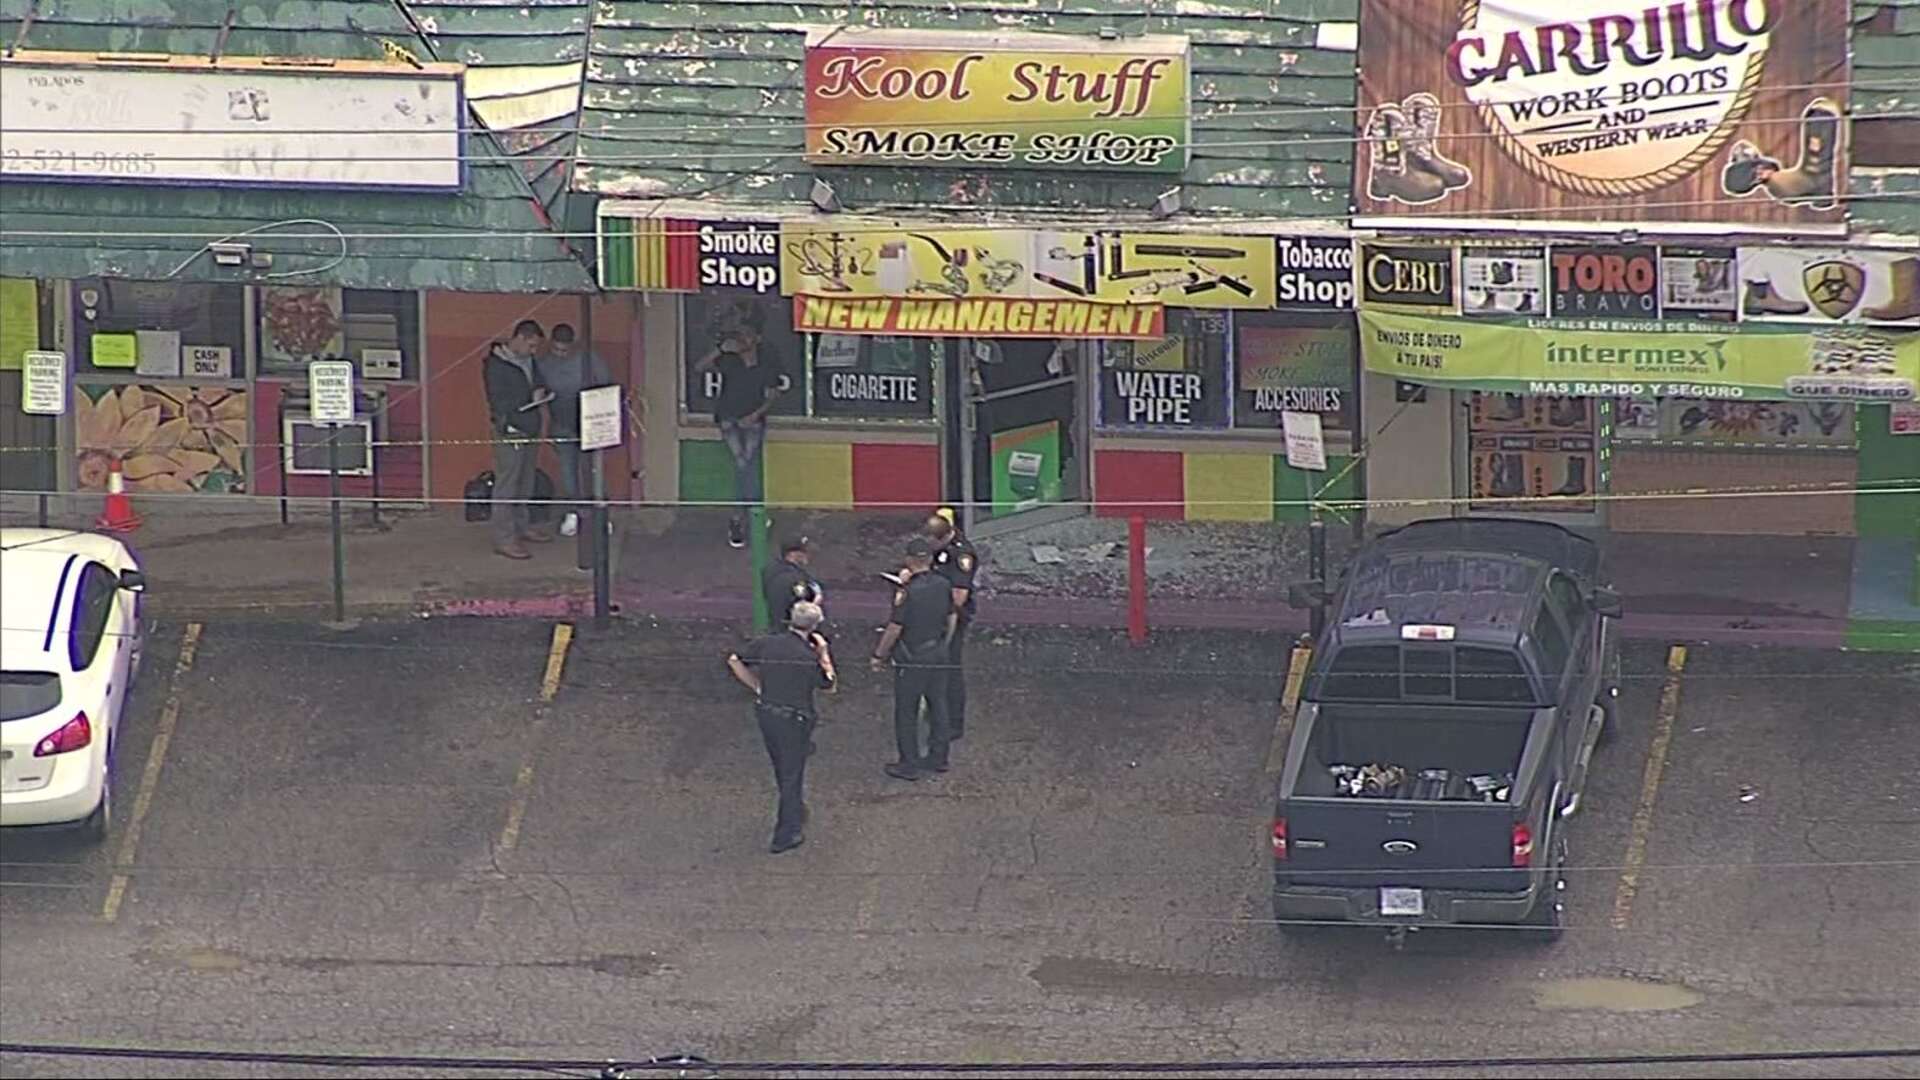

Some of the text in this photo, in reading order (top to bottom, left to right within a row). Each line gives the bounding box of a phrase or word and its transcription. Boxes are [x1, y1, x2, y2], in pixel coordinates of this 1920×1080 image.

[1447, 0, 1781, 87] CARRILLO
[818, 54, 1171, 118] Kool Stuff
[1508, 66, 1728, 122] WORK BOOTS
[1596, 108, 1646, 129] AND
[821, 128, 1175, 165] SMOKE SHOP
[1536, 118, 1708, 157] WESTERN WEAR
[0, 148, 156, 174] 2-521-9685
[701, 227, 776, 255] Smoke
[1280, 238, 1351, 269] Tobacco
[701, 257, 776, 292] Shop
[1367, 253, 1450, 295] CEBU
[1552, 254, 1654, 293] TORO
[1280, 273, 1351, 307] Shop
[802, 299, 1160, 334] NEW MANAGEMENT
[1589, 320, 1608, 330] EN
[1666, 322, 1685, 332] DE
[1136, 335, 1181, 366] Discount
[1377, 330, 1461, 349] ENVIOS DE DINERO
[194, 350, 219, 360] CASH
[194, 361, 218, 372] ONLY
[1404, 353, 1417, 366] TU
[831, 373, 917, 401] CIGARETTE
[1116, 371, 1201, 399] WATER
[1255, 387, 1341, 411] ACCESORIES
[1530, 382, 1743, 397] MAS RAPIDO Y SEGURO
[1792, 385, 1910, 397] QUE DINERO
[1129, 398, 1191, 424] PIPE
